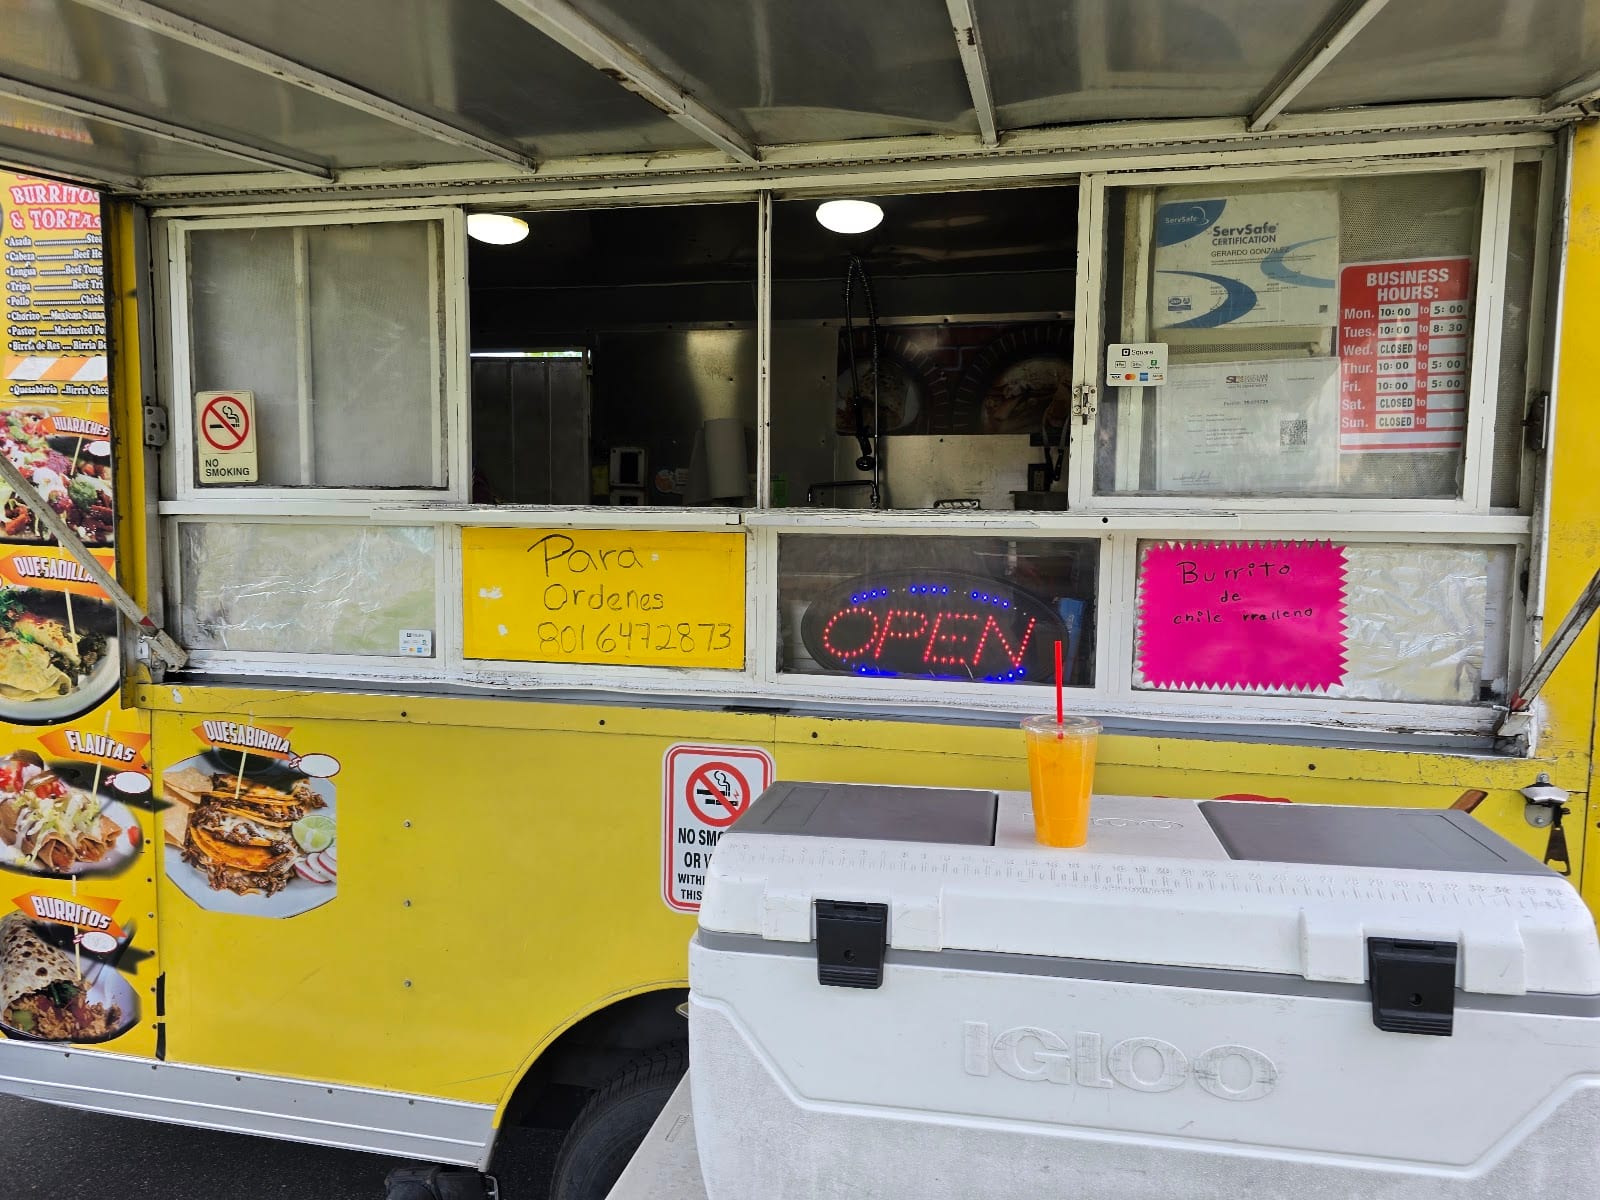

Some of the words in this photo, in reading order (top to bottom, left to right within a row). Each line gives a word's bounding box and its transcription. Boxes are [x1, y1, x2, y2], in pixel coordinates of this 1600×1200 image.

[11, 211, 26, 230] &
[10, 236, 32, 247] Asada
[1212, 235, 1277, 247] CERTIFICATION
[10, 251, 36, 262] Cabeza
[73, 249, 91, 260] Beef
[1211, 248, 1248, 258] GERARDO
[10, 267, 38, 279] Lengua
[65, 264, 83, 275] Beef
[1367, 269, 1450, 287] BUSINESS
[10, 281, 32, 293] Tripa
[72, 279, 91, 290] Beef
[1378, 286, 1439, 301] HOURS:
[11, 296, 31, 306] Pollo
[1344, 308, 1375, 320] Mon.
[1420, 305, 1430, 314] to
[12, 326, 37, 337] Pastor
[54, 324, 94, 336] Marinated
[1344, 326, 1376, 338] Tues.
[1419, 324, 1429, 333] to
[13, 341, 36, 352] Birria
[36, 340, 46, 351] de
[47, 341, 61, 351] Res
[73, 340, 97, 351] Birria
[1343, 344, 1373, 355] Wed.
[1380, 343, 1413, 354] CLOSED
[1418, 342, 1428, 351] to
[1342, 362, 1374, 375] Thur.
[1418, 361, 1427, 370] to
[1342, 381, 1361, 392] Fri.
[1417, 380, 1427, 389] to
[1341, 398, 1366, 410] Sat.
[1380, 398, 1413, 408] CLOSED
[1416, 398, 1426, 407] to
[52, 415, 110, 437] HUARACHES
[1341, 417, 1369, 428] Sun.
[1379, 416, 1412, 426] CLOSED
[1416, 416, 1426, 425] to
[205, 458, 219, 467] NO
[206, 467, 250, 477] SMOKING
[527, 534, 643, 577] Para
[1176, 561, 1290, 584] Burrito
[544, 583, 664, 611] Ordenes
[1220, 590, 1242, 603] de
[823, 606, 1036, 668] OPEN
[203, 719, 290, 754] QUESABIRRIA
[65, 730, 136, 762] FLAUTAS
[678, 827, 696, 845] NO
[684, 851, 701, 869] OR
[680, 889, 703, 901] THIS
[30, 895, 112, 930] BURRITOS
[963, 1020, 1280, 1101] IGLOO
